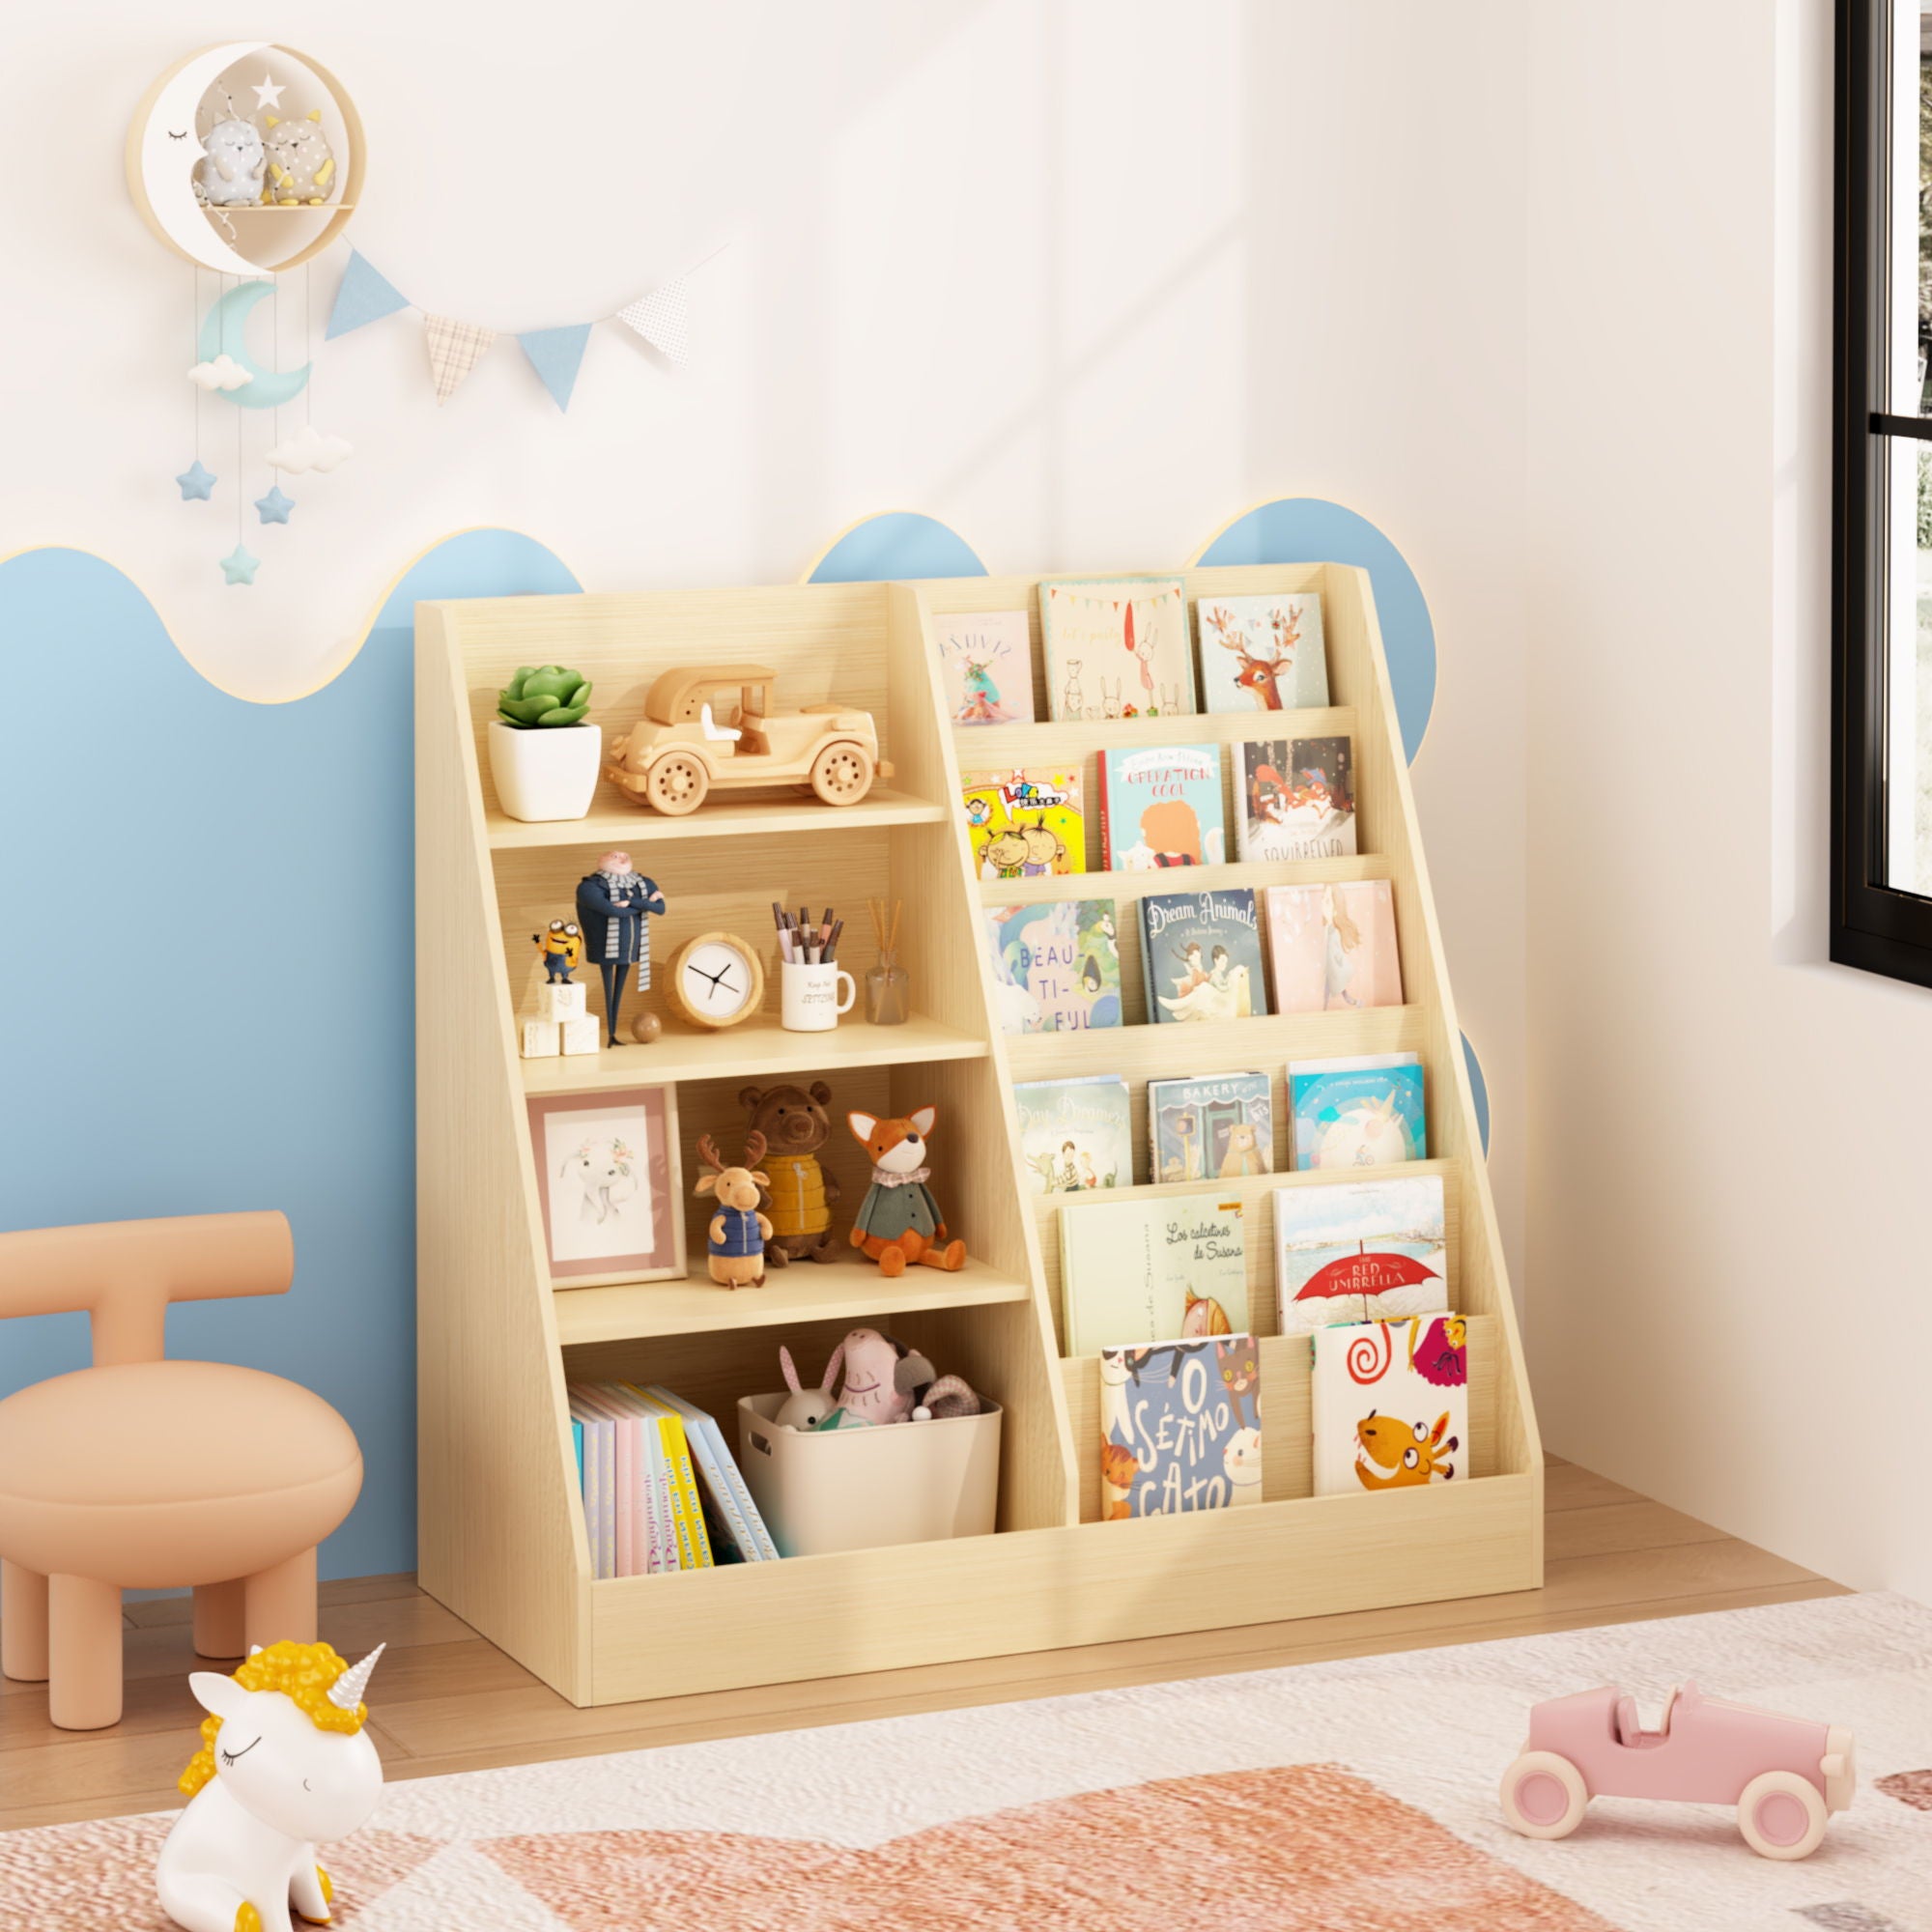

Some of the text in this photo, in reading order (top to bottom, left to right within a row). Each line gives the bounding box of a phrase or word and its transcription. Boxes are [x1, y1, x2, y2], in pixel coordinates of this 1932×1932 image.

[1151, 783, 1187, 797] COOL
[1147, 891, 1258, 939] Dream Animals
[1182, 1083, 1238, 1099] BAKERY
[1166, 1222, 1231, 1244] Los calcetines
[1194, 1240, 1243, 1260] de Susana
[1352, 1263, 1380, 1277] RED
[1329, 1272, 1406, 1292] UMBRELLA
[1182, 1358, 1207, 1414] O
[1135, 1400, 1229, 1473] SÉTIMO
